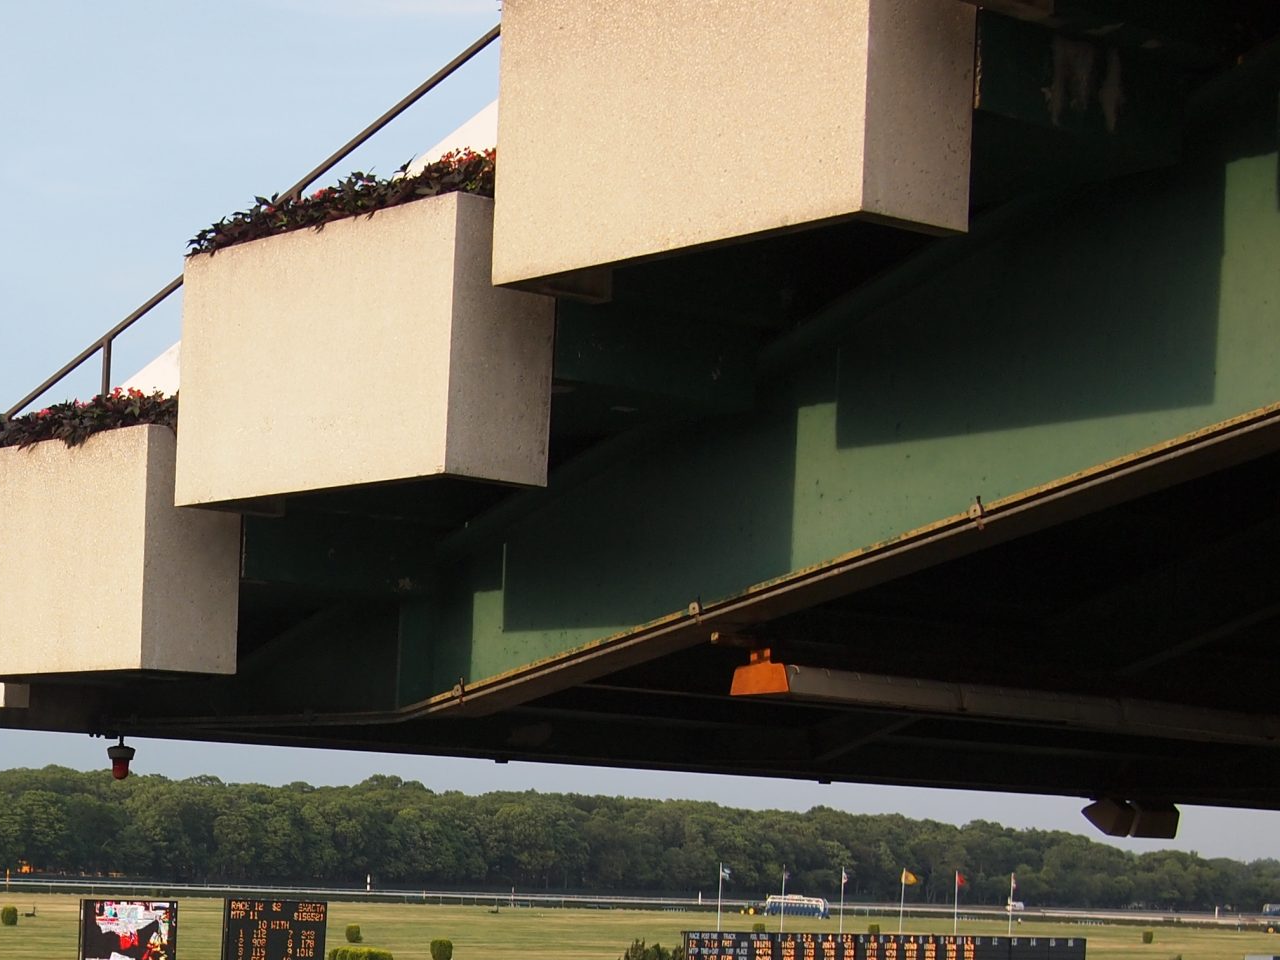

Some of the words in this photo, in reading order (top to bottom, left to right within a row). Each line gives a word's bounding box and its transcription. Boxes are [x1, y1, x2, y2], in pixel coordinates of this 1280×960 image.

[231, 901, 250, 910] RACE
[255, 902, 264, 910] 12
[231, 911, 246, 919] MTP
[250, 911, 258, 919] 11
[271, 921, 290, 929] WITH
